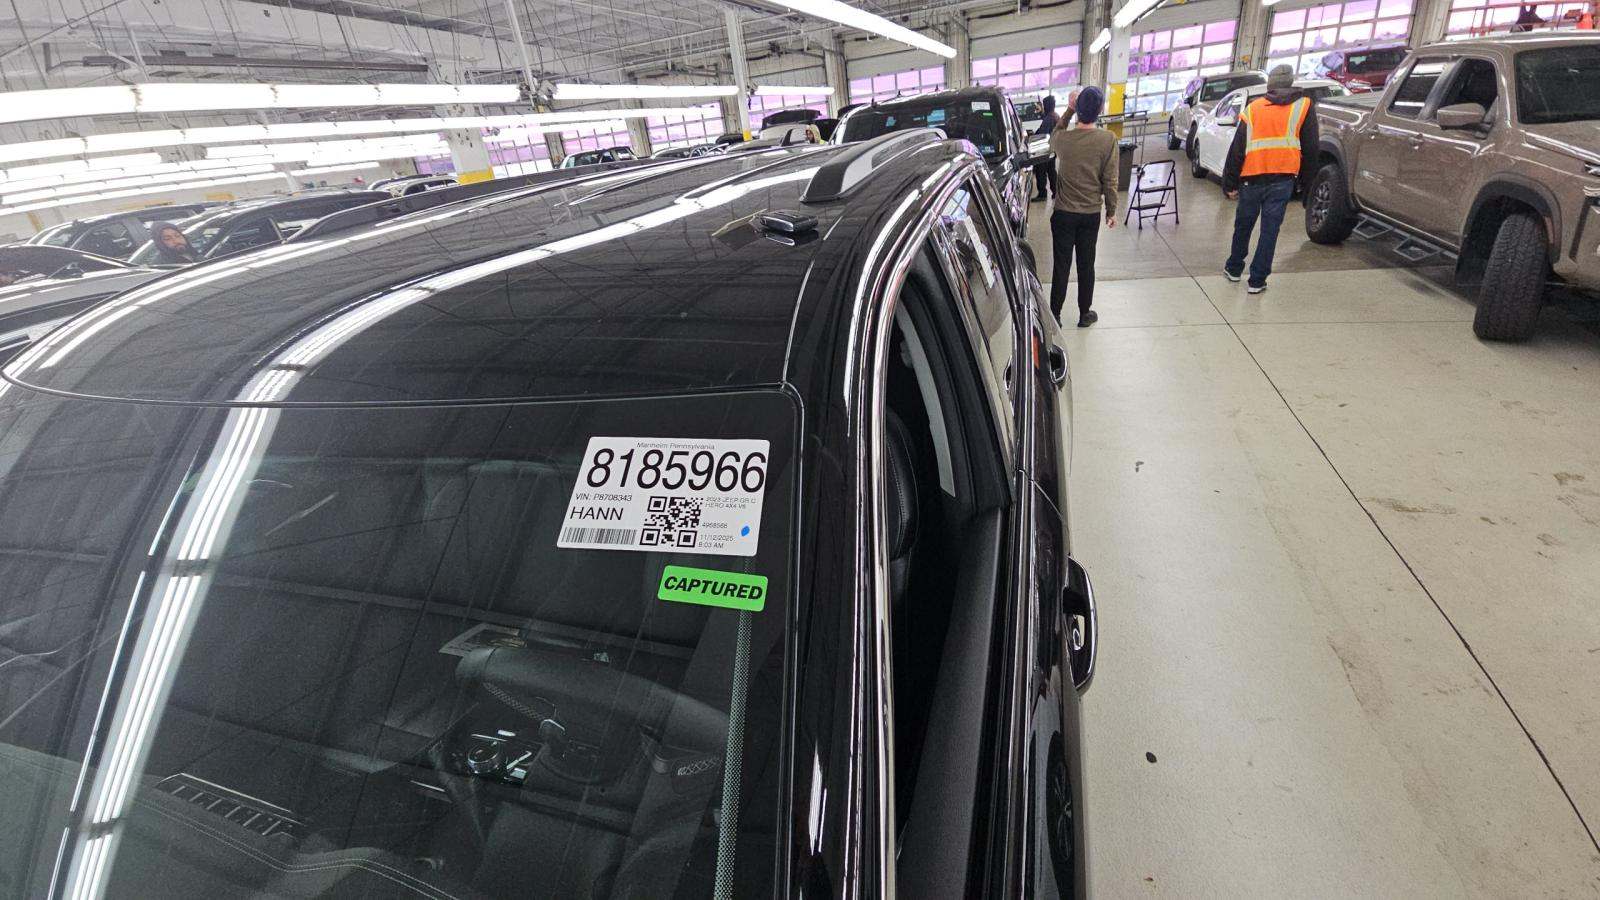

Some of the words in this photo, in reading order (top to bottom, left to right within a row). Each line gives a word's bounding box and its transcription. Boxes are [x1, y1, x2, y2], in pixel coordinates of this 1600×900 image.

[586, 448, 767, 493] 8185966
[575, 493, 591, 501] VIN:
[569, 506, 624, 521] HANN
[664, 576, 763, 600] CAPTURED
